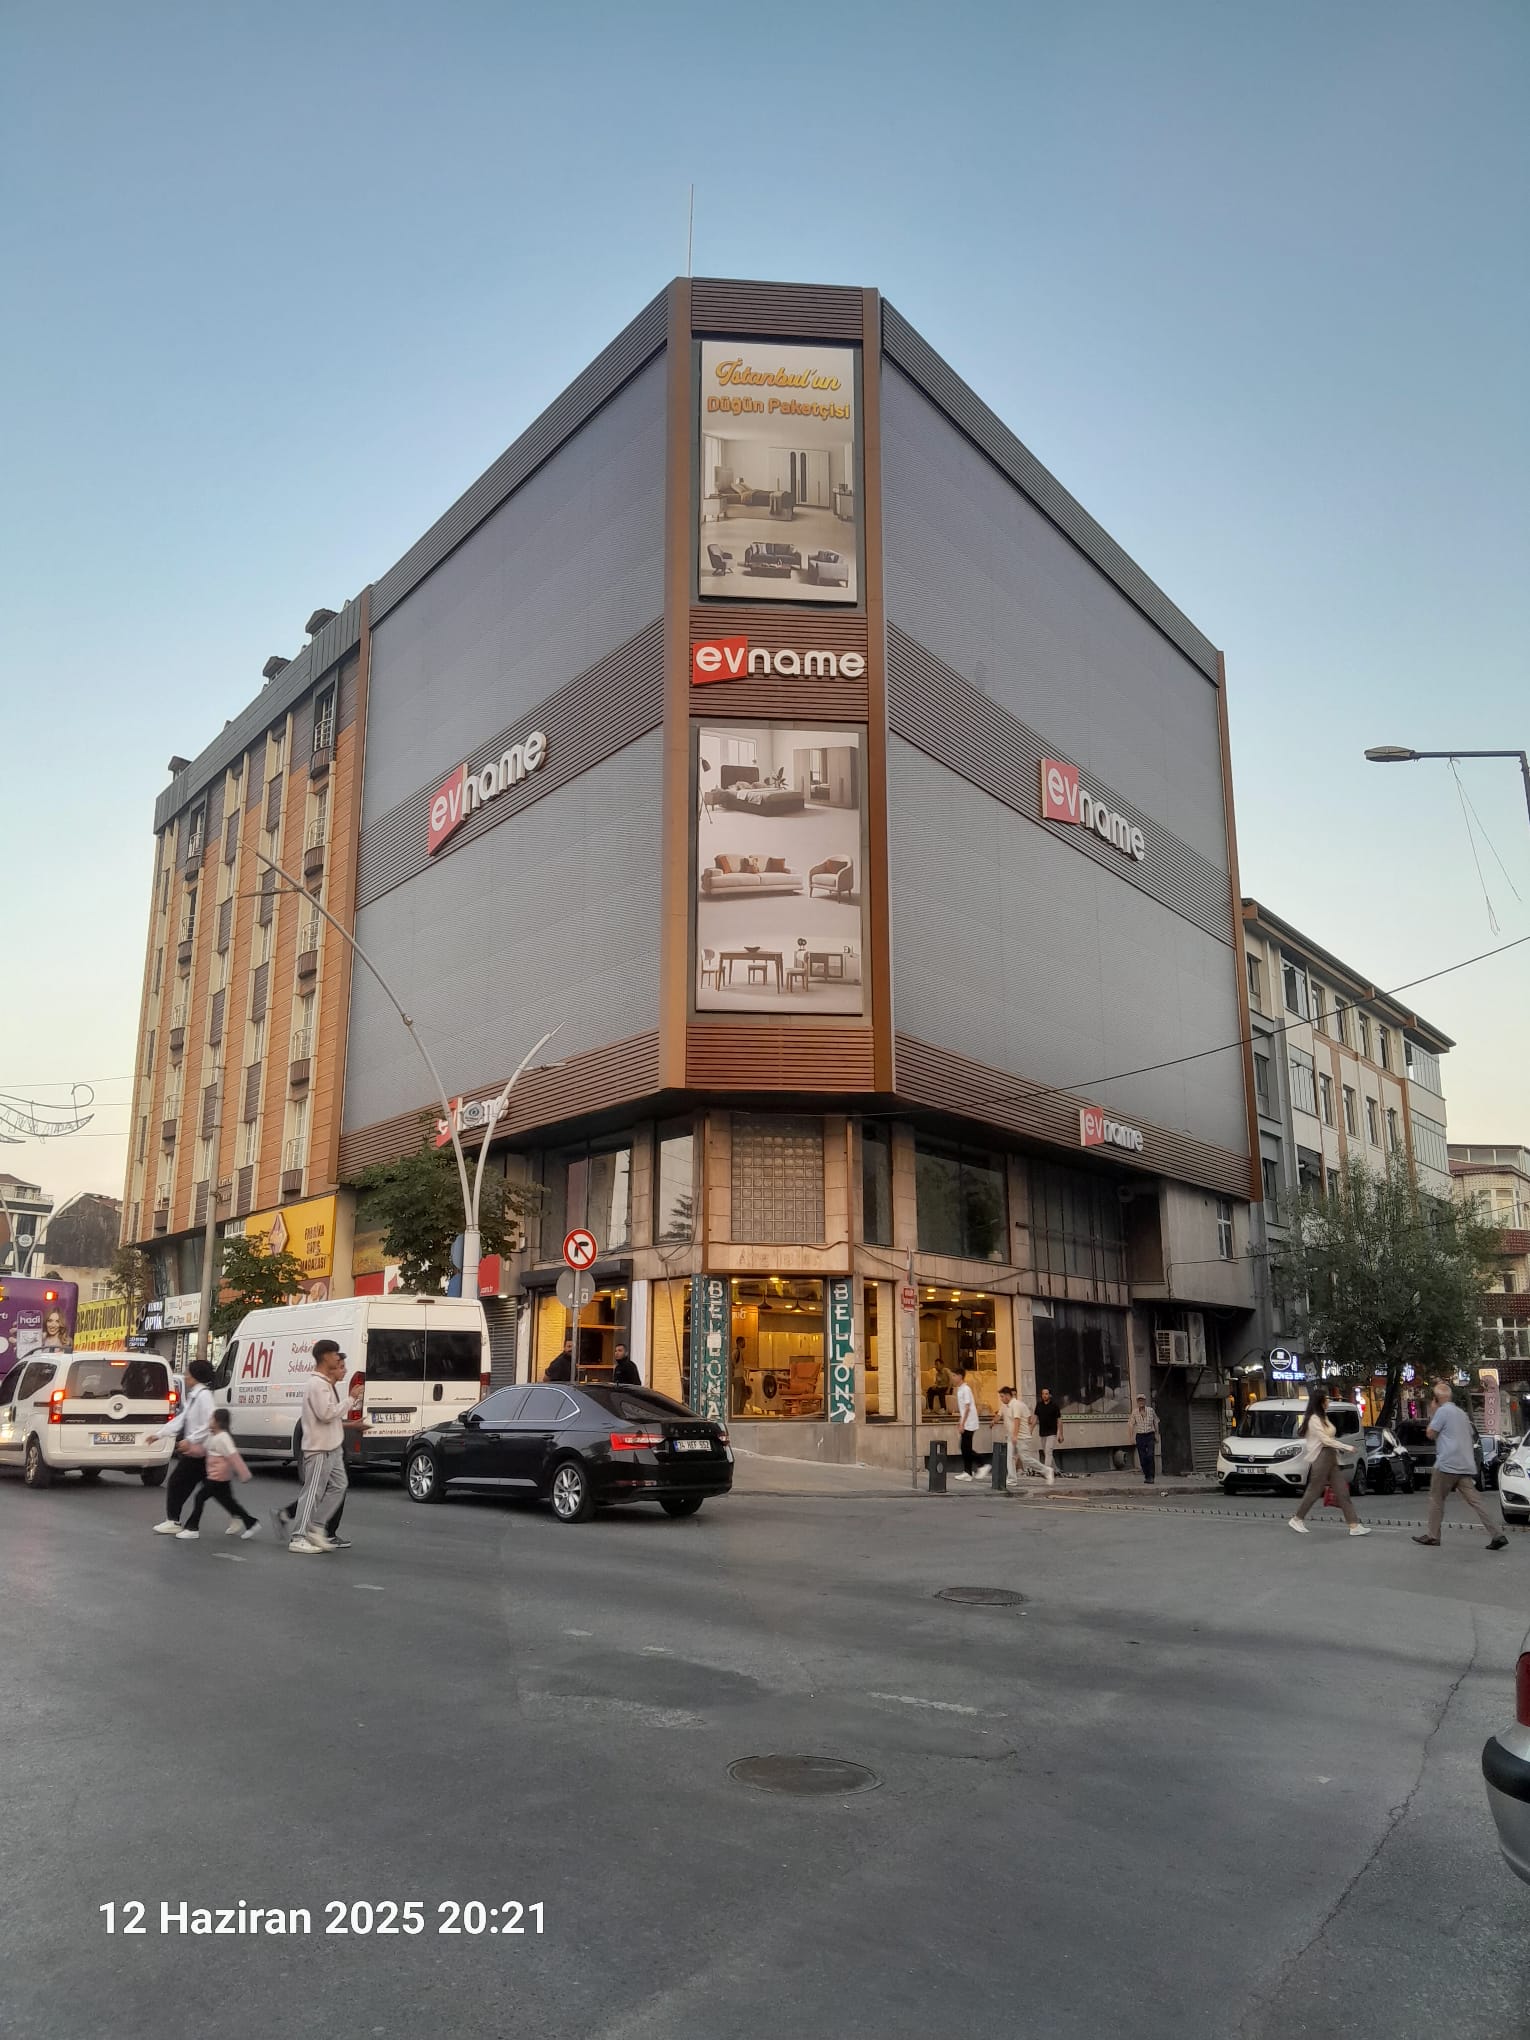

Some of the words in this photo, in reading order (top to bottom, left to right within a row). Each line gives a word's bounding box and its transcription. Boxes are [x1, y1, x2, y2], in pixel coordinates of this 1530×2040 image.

[707, 396, 764, 416] Düğün
[768, 398, 850, 420] Paketçisi
[695, 646, 866, 679] evname
[431, 731, 547, 832] evname
[1047, 767, 1145, 861] evname
[1084, 1113, 1144, 1152] evname
[241, 1341, 275, 1379] Ahi
